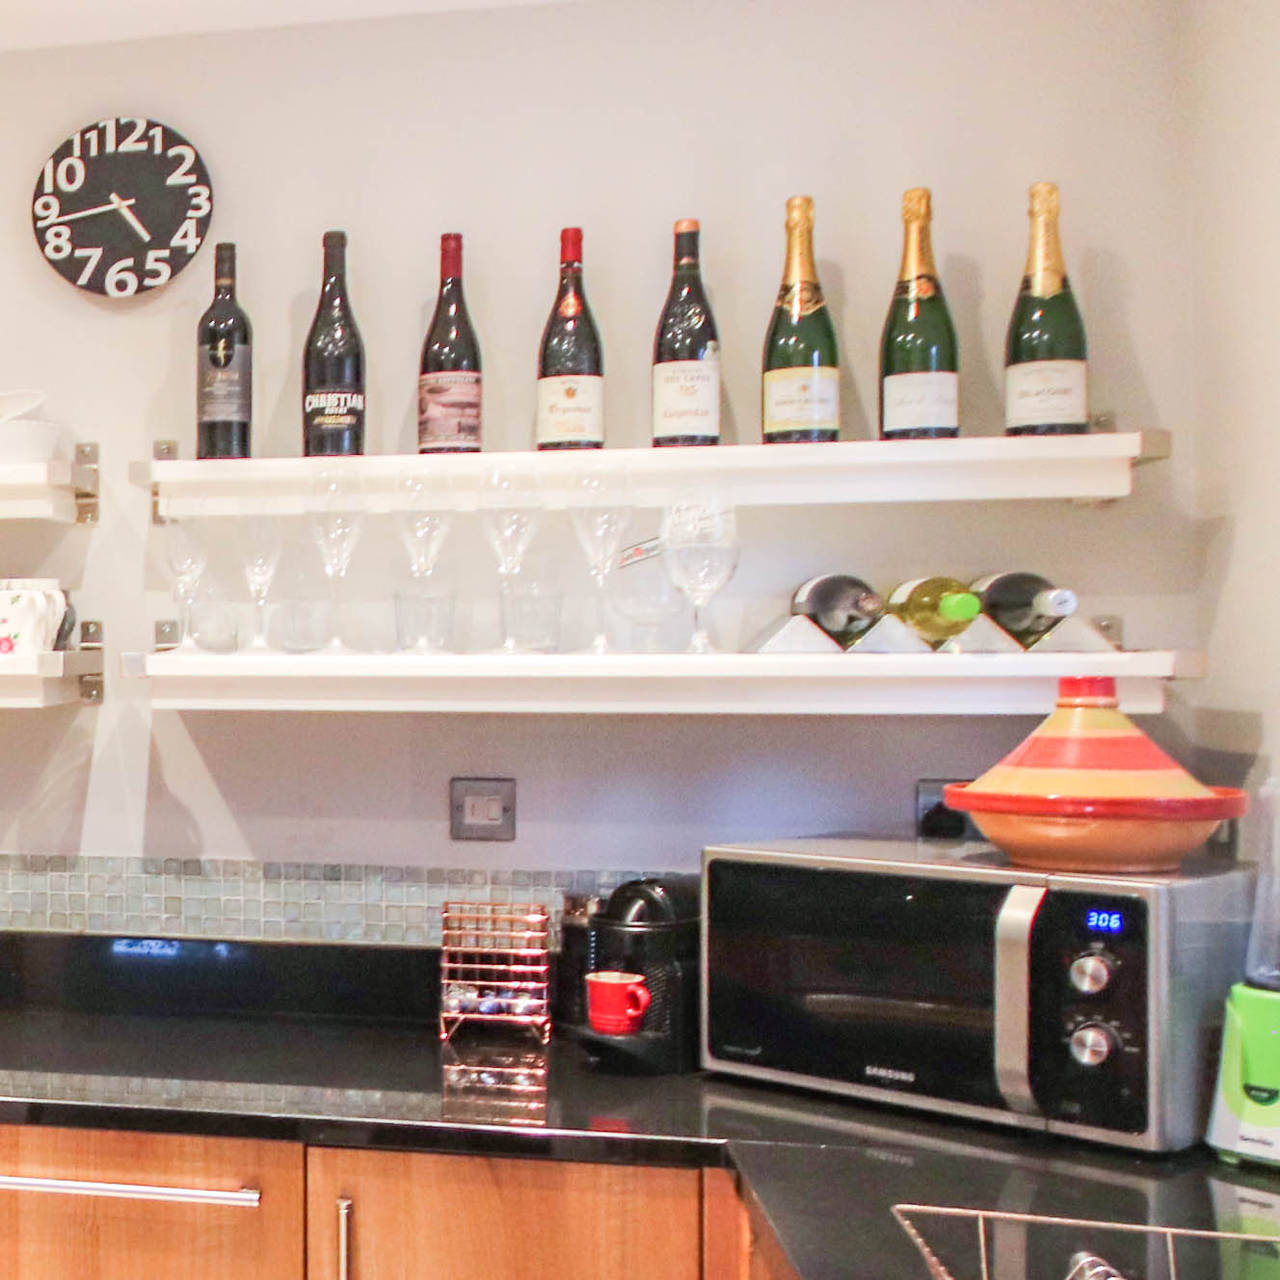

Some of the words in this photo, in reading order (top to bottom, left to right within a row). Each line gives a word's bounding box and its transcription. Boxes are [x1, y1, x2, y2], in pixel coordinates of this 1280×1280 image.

[72, 129, 99, 157] 11
[98, 117, 149, 154] 12
[149, 126, 163, 154] 1
[43, 156, 86, 194] 10
[166, 145, 197, 186] 2
[33, 195, 61, 228] 9
[186, 185, 211, 218] 3
[44, 225, 73, 261] 8
[170, 218, 201, 254] 4
[74, 248, 104, 286] 7
[104, 257, 139, 298] 6
[143, 249, 172, 287] 5
